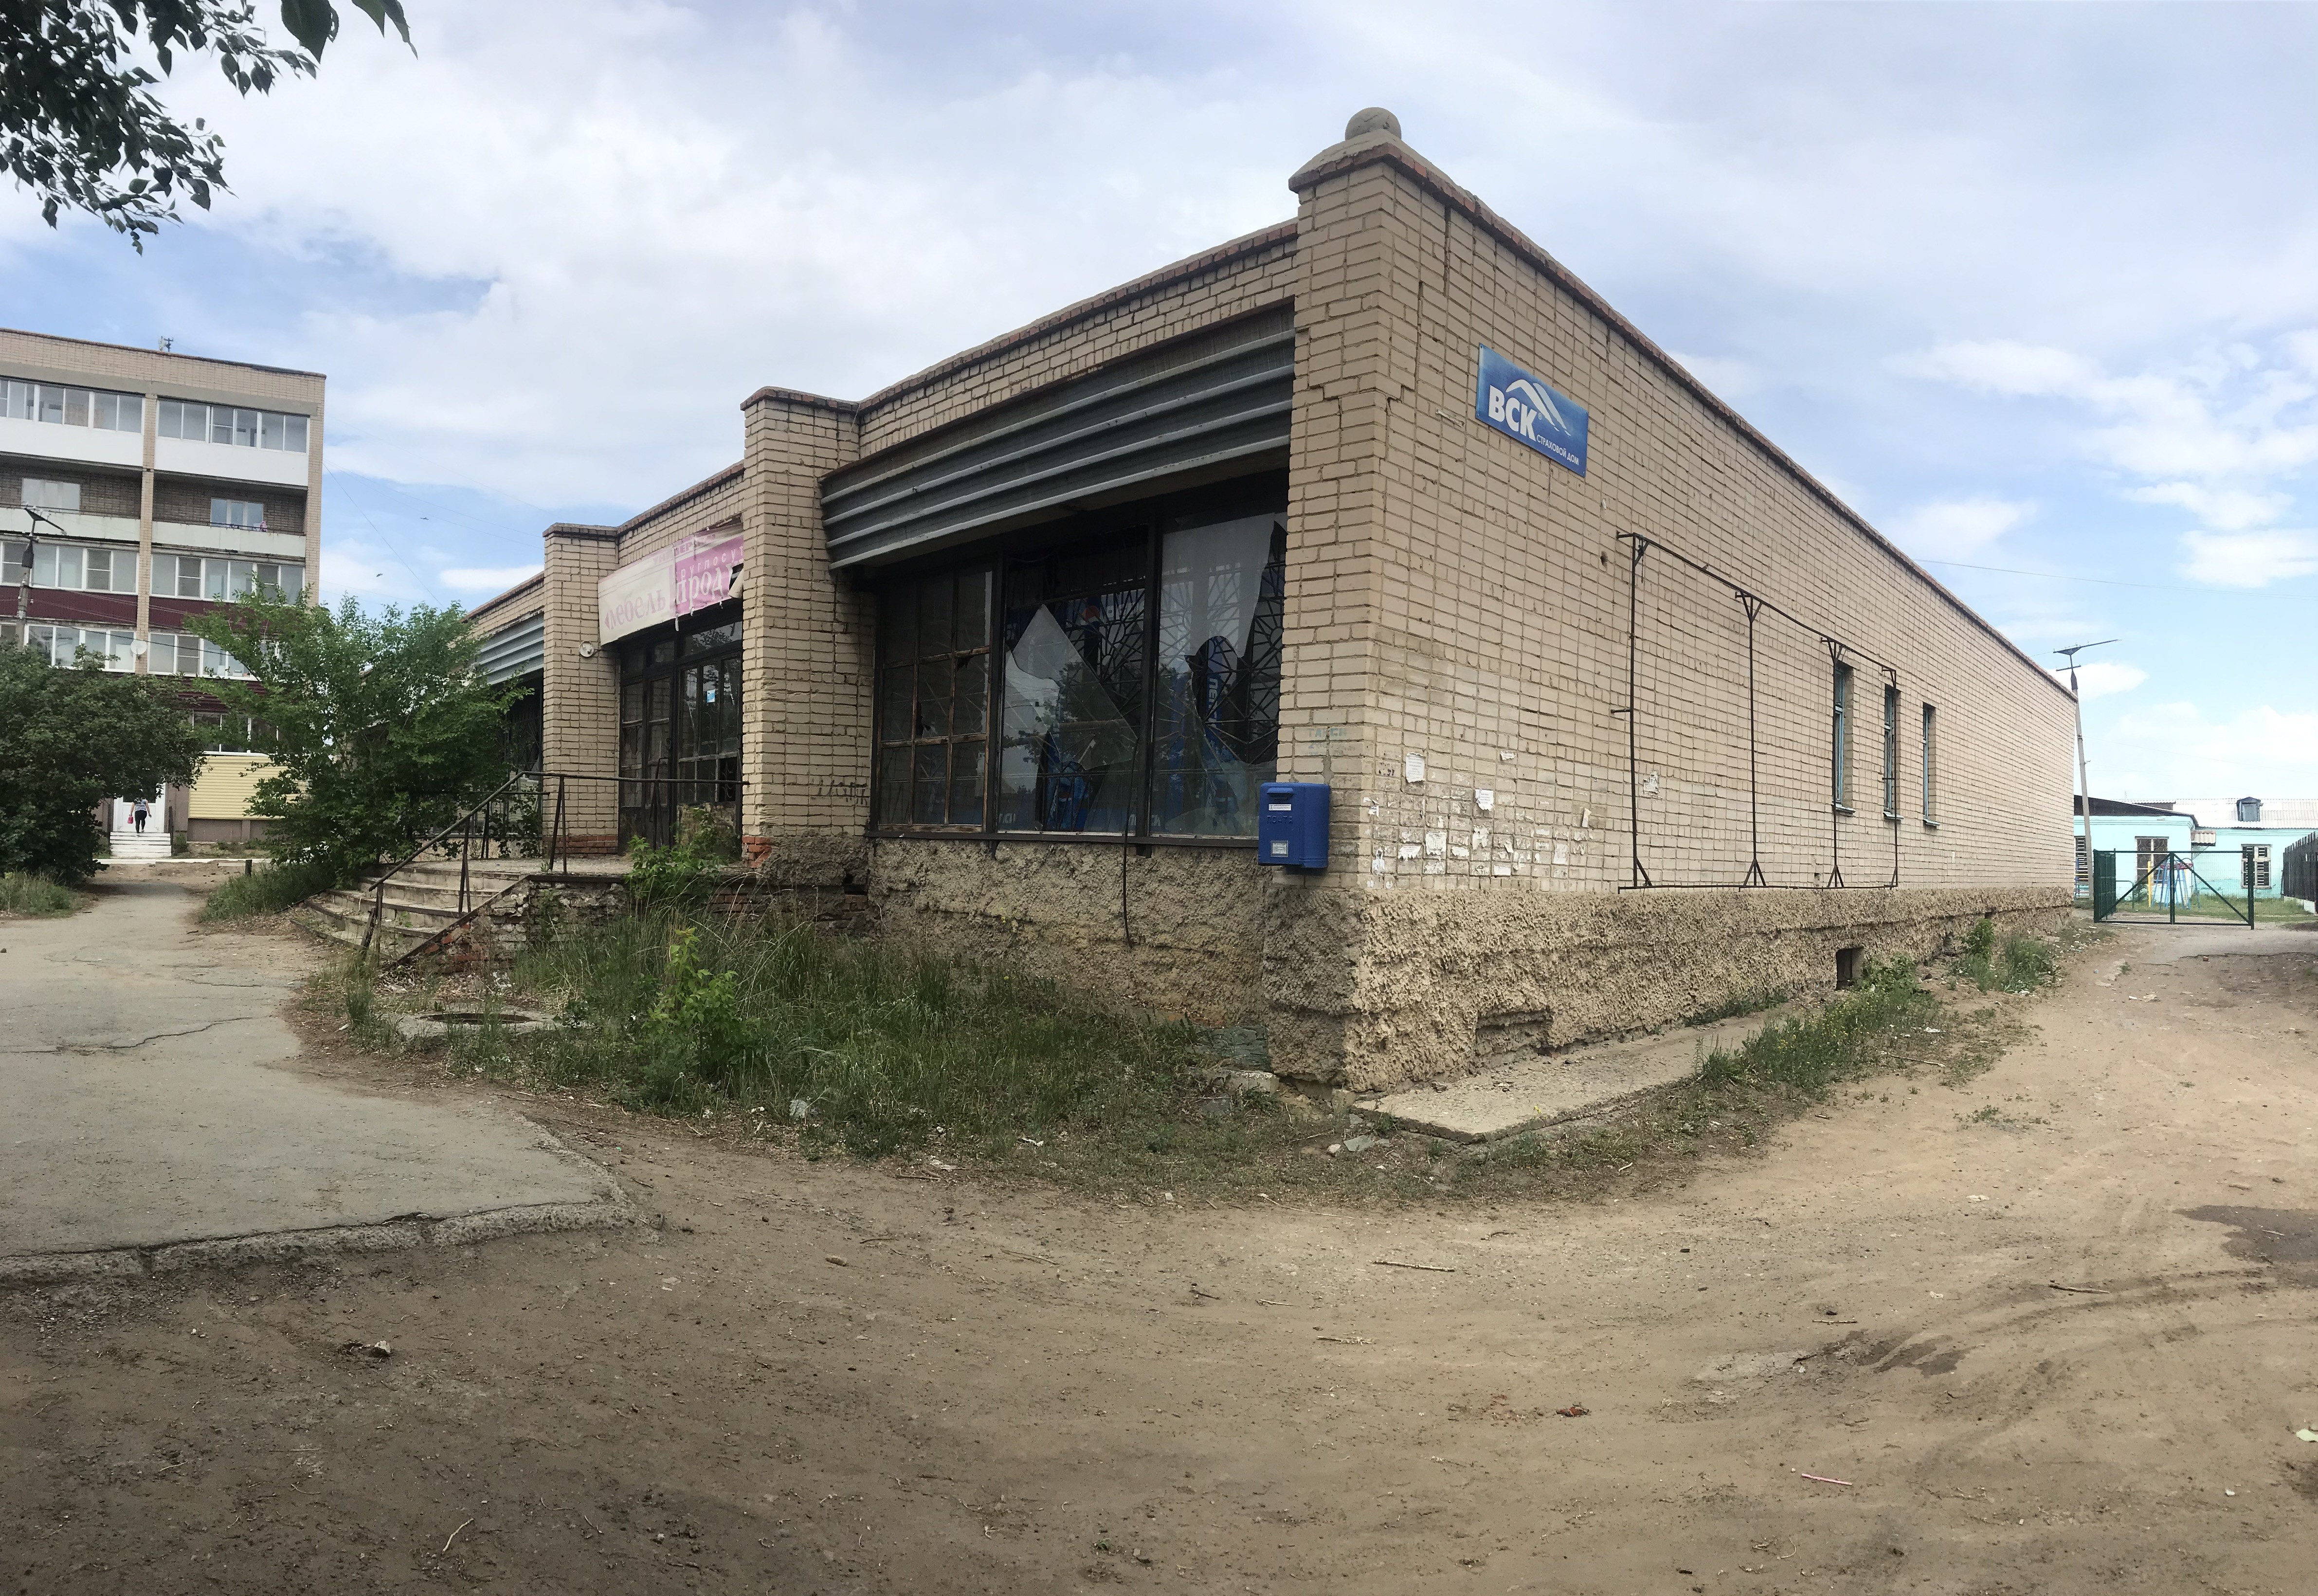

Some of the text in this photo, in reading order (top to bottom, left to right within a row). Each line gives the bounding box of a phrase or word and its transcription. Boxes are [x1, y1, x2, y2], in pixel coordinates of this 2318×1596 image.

[1488, 385, 1536, 442] ВСК
[1537, 434, 1579, 466] СТРАХОВОЙ ДОМ
